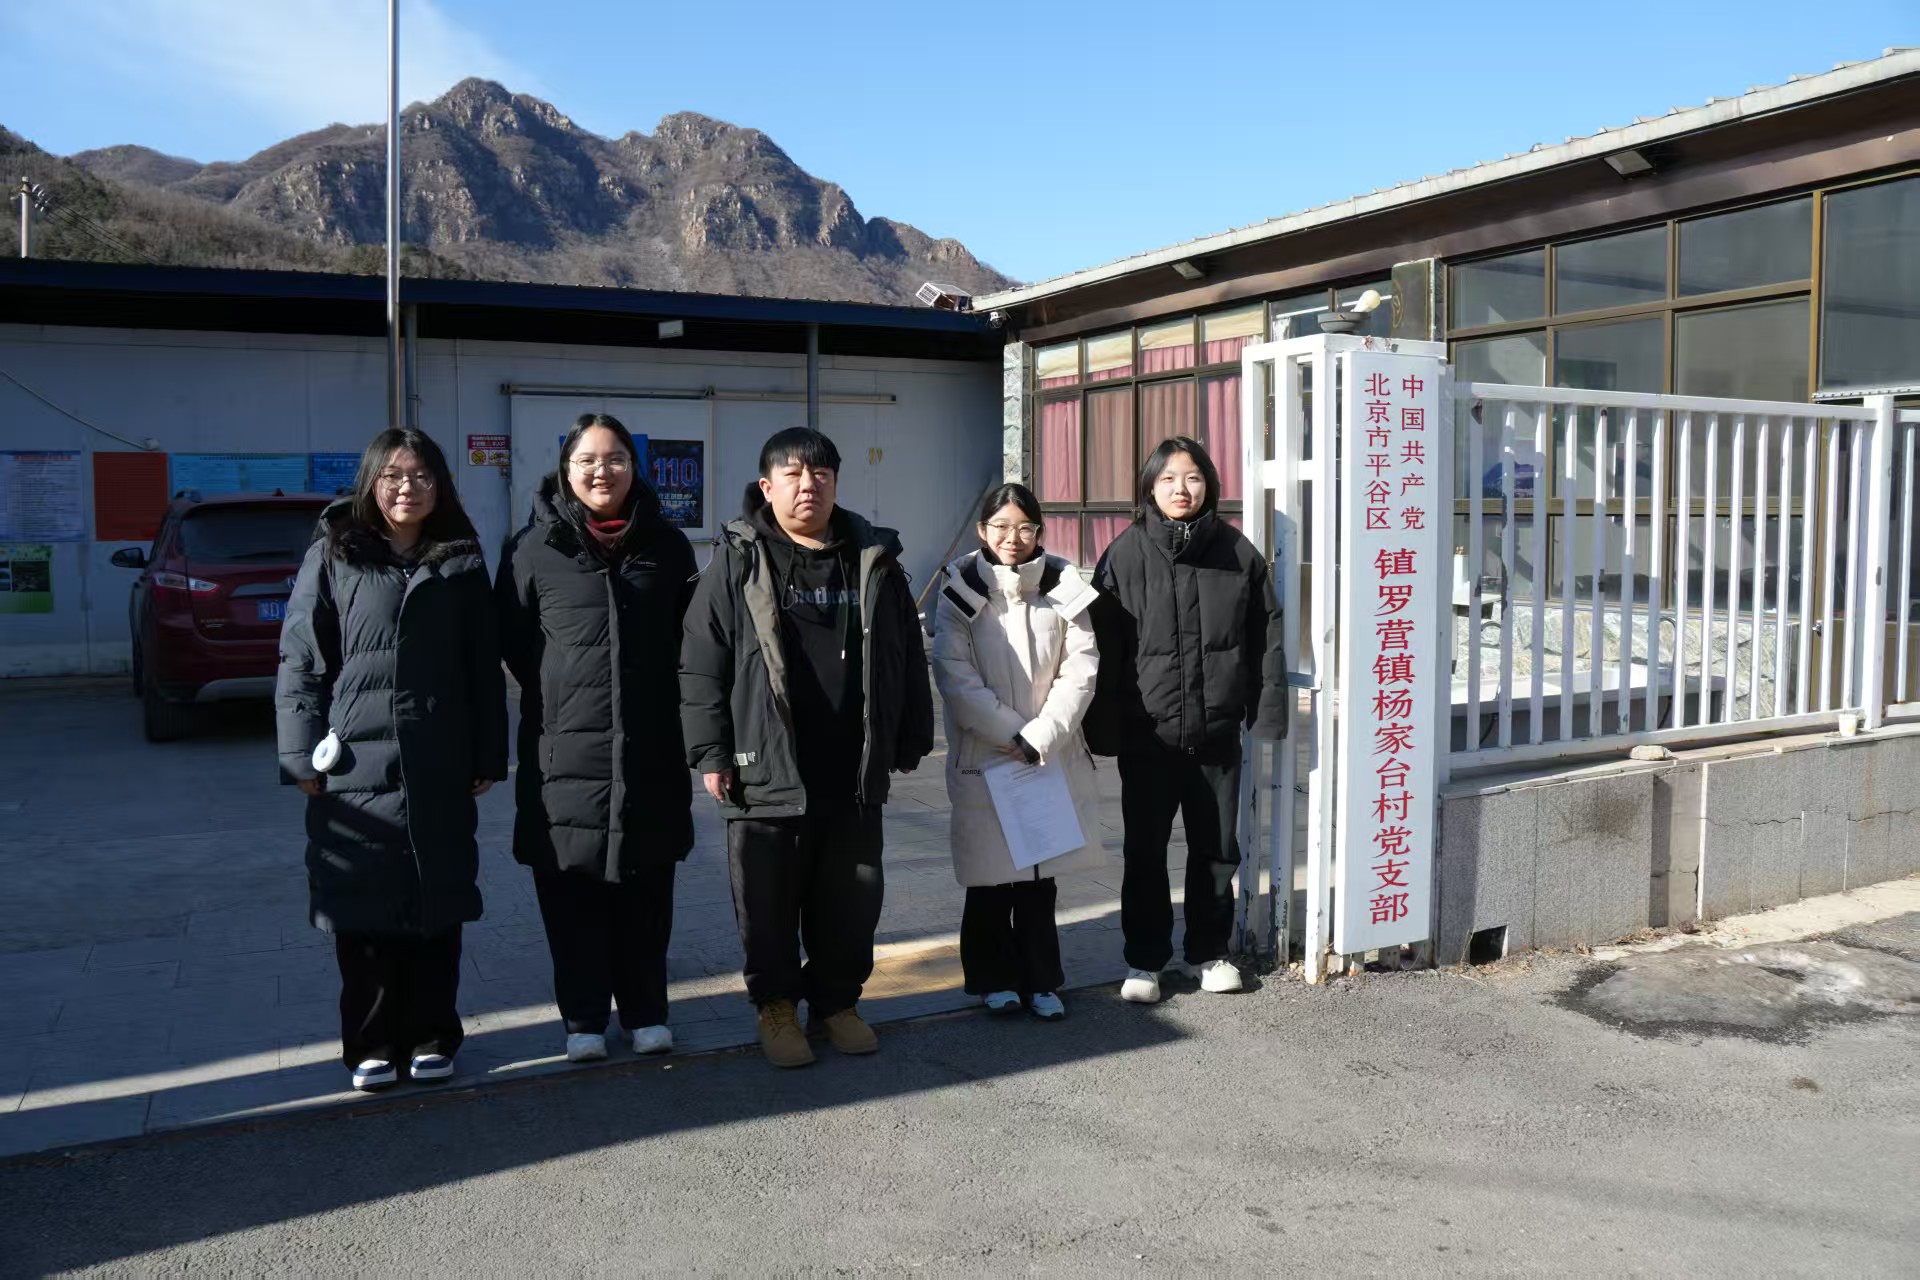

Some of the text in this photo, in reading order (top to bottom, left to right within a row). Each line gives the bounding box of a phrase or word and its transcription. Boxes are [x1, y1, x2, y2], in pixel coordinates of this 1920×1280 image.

[654, 457, 698, 488] 110
[1364, 373, 1392, 530] 北京市平谷区
[1400, 374, 1425, 530] 中国共产党
[1369, 547, 1417, 926] 镇罗营镇杨家台村党支部
